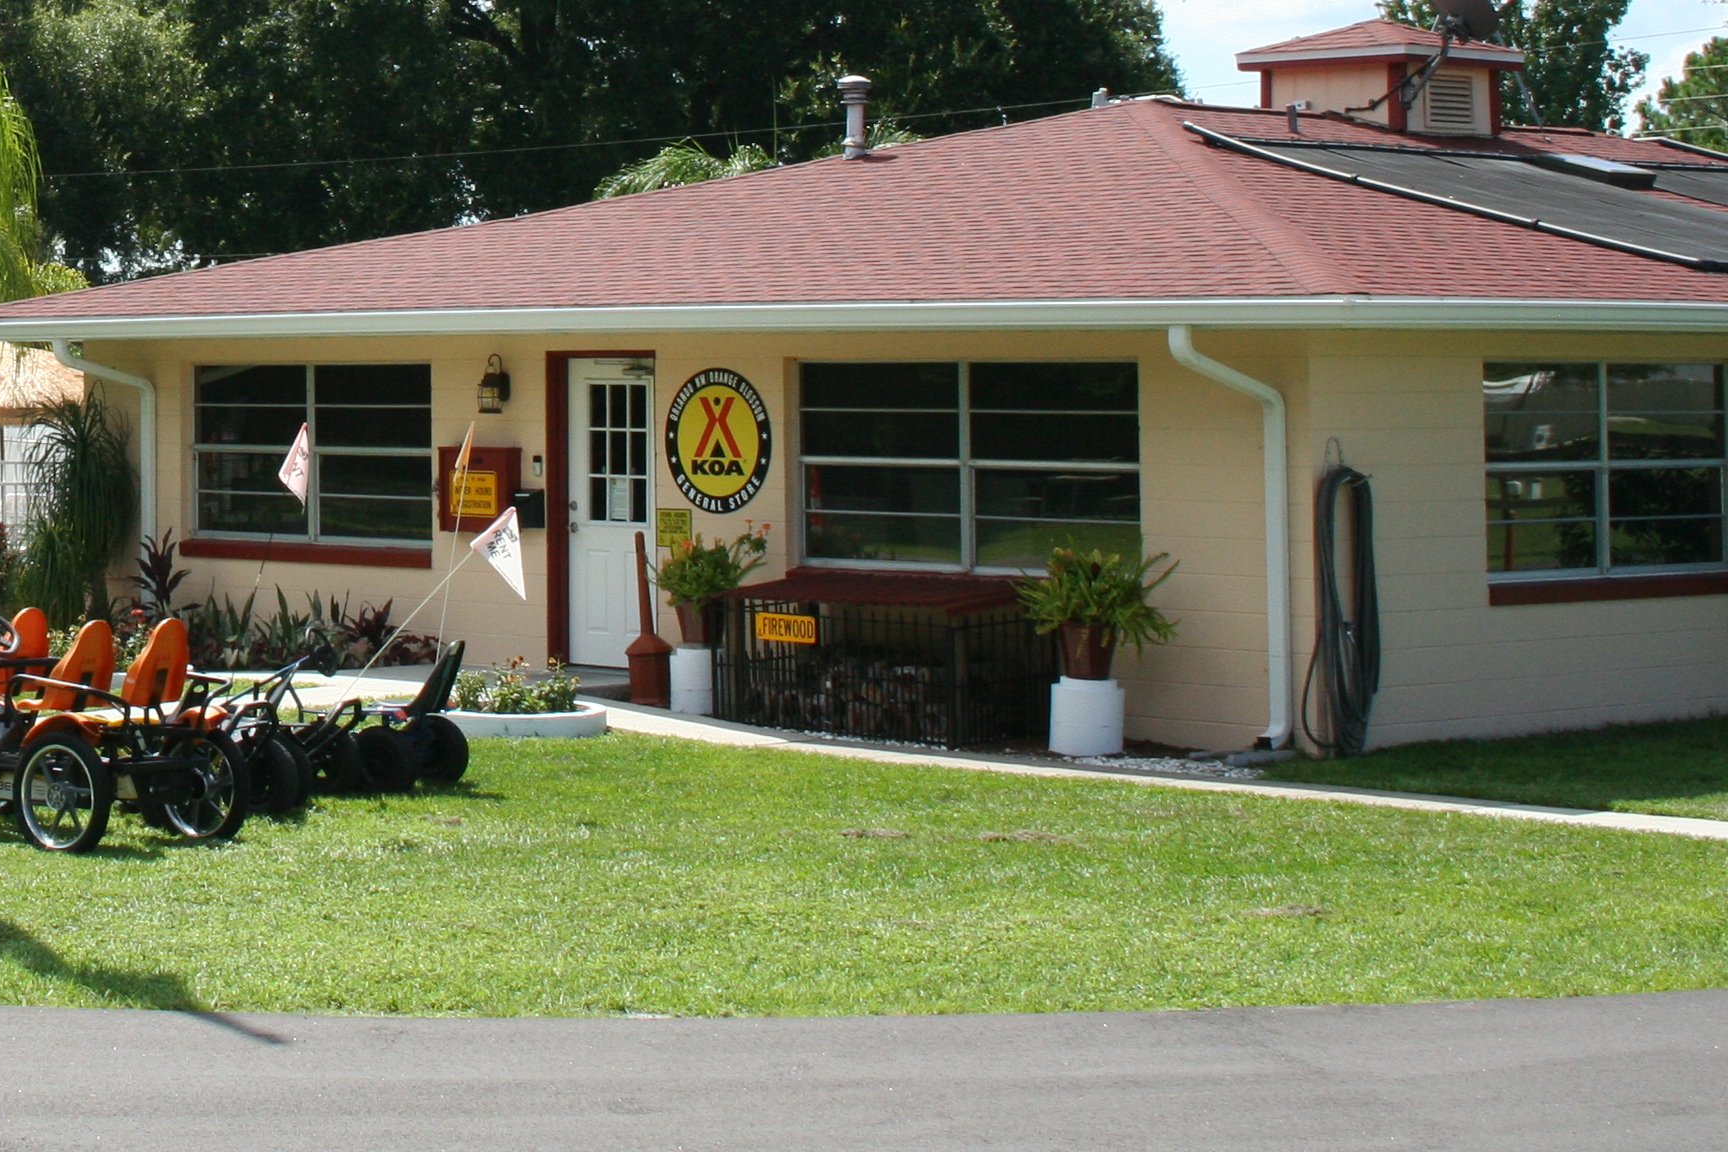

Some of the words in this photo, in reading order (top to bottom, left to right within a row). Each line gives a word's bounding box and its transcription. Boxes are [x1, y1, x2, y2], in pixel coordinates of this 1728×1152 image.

[669, 382, 694, 422] ORLANDO
[738, 382, 766, 422] BLOSSOM
[691, 459, 745, 476] KOA
[676, 474, 723, 512] GENERAL
[728, 475, 761, 510] STORE
[485, 540, 501, 559] ME
[492, 529, 512, 559] RENT
[762, 616, 814, 639] FIREWOOD
